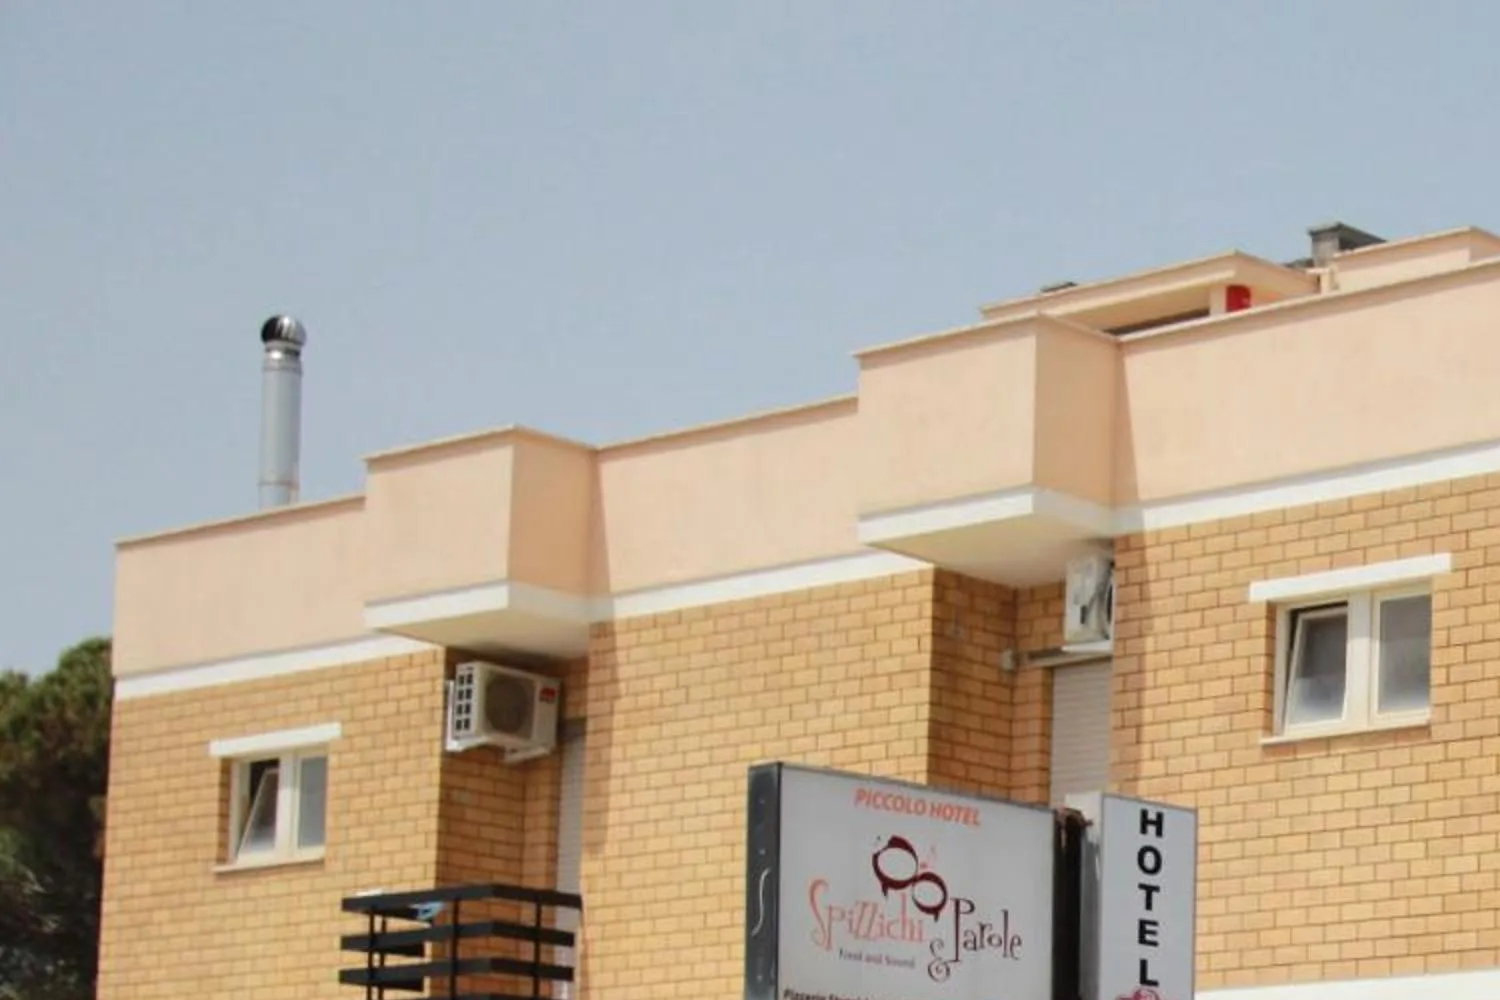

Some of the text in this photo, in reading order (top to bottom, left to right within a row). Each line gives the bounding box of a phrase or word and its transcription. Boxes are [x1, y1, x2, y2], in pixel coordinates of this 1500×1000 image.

[854, 788, 981, 826] PICCOLO HOTEL
[950, 897, 1023, 961] Parole
[1137, 808, 1164, 987] HOTEL
